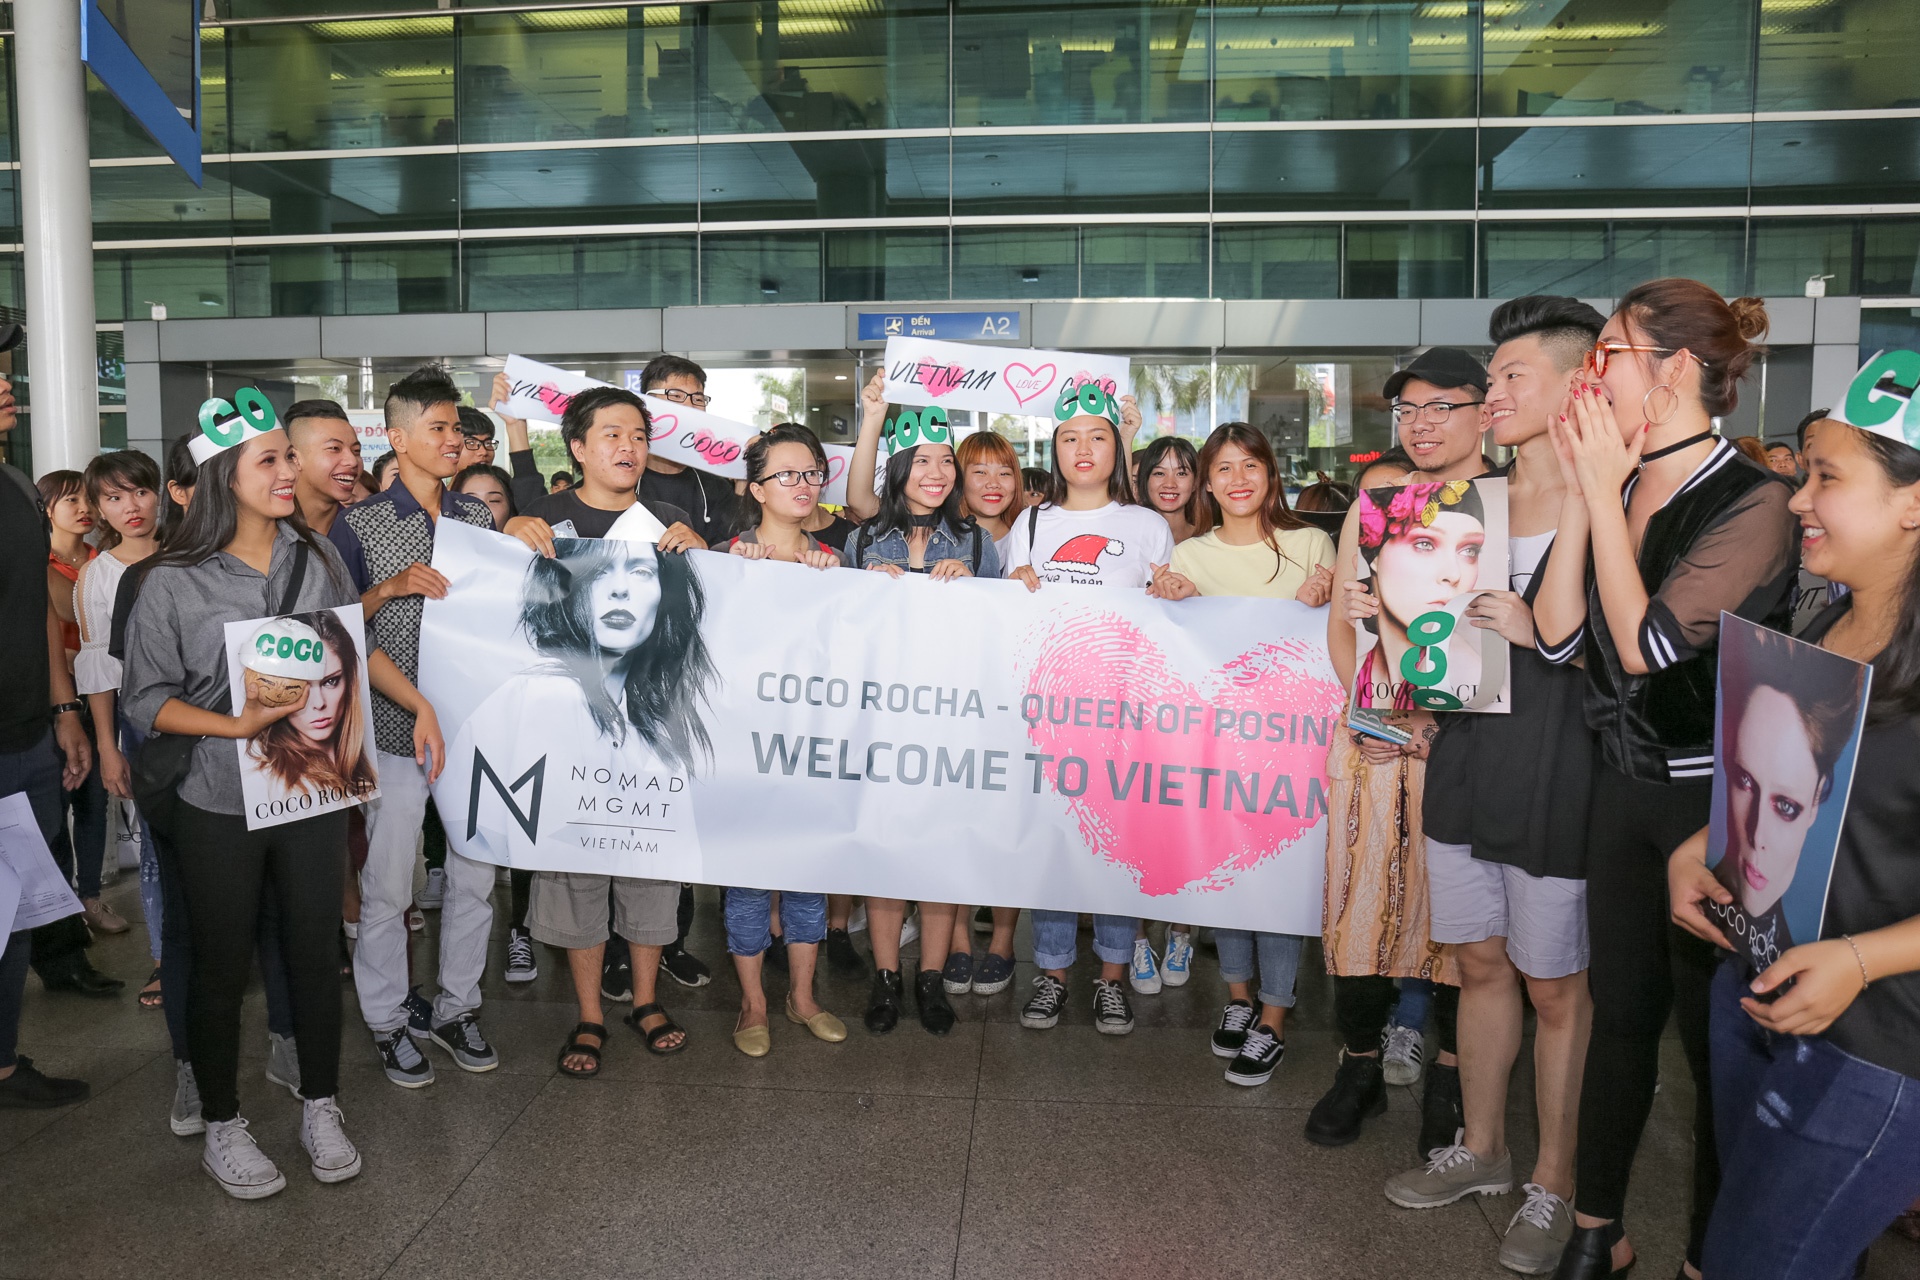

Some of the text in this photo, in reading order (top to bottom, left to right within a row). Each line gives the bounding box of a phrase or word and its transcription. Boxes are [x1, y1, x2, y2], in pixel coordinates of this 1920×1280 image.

[911, 328, 936, 336] Arrival
[980, 316, 1011, 335] A2
[889, 360, 997, 391] VIETNAM
[1015, 378, 1043, 390] LOVE
[511, 380, 573, 408] VIET
[679, 431, 721, 463] COCO
[255, 633, 324, 664] COCO
[756, 671, 849, 708] COCO
[860, 680, 985, 719] ROCHA
[1021, 693, 1144, 731] QUEEN
[1156, 703, 1203, 735] OF
[1214, 707, 1338, 747] POSIN
[751, 731, 1009, 792] WELCOME
[1025, 752, 1089, 797] TO
[571, 765, 684, 793] NOMAD
[255, 779, 378, 820] COCO ROCHA
[578, 796, 671, 818] MGMT
[580, 836, 659, 853] VIETNAM
